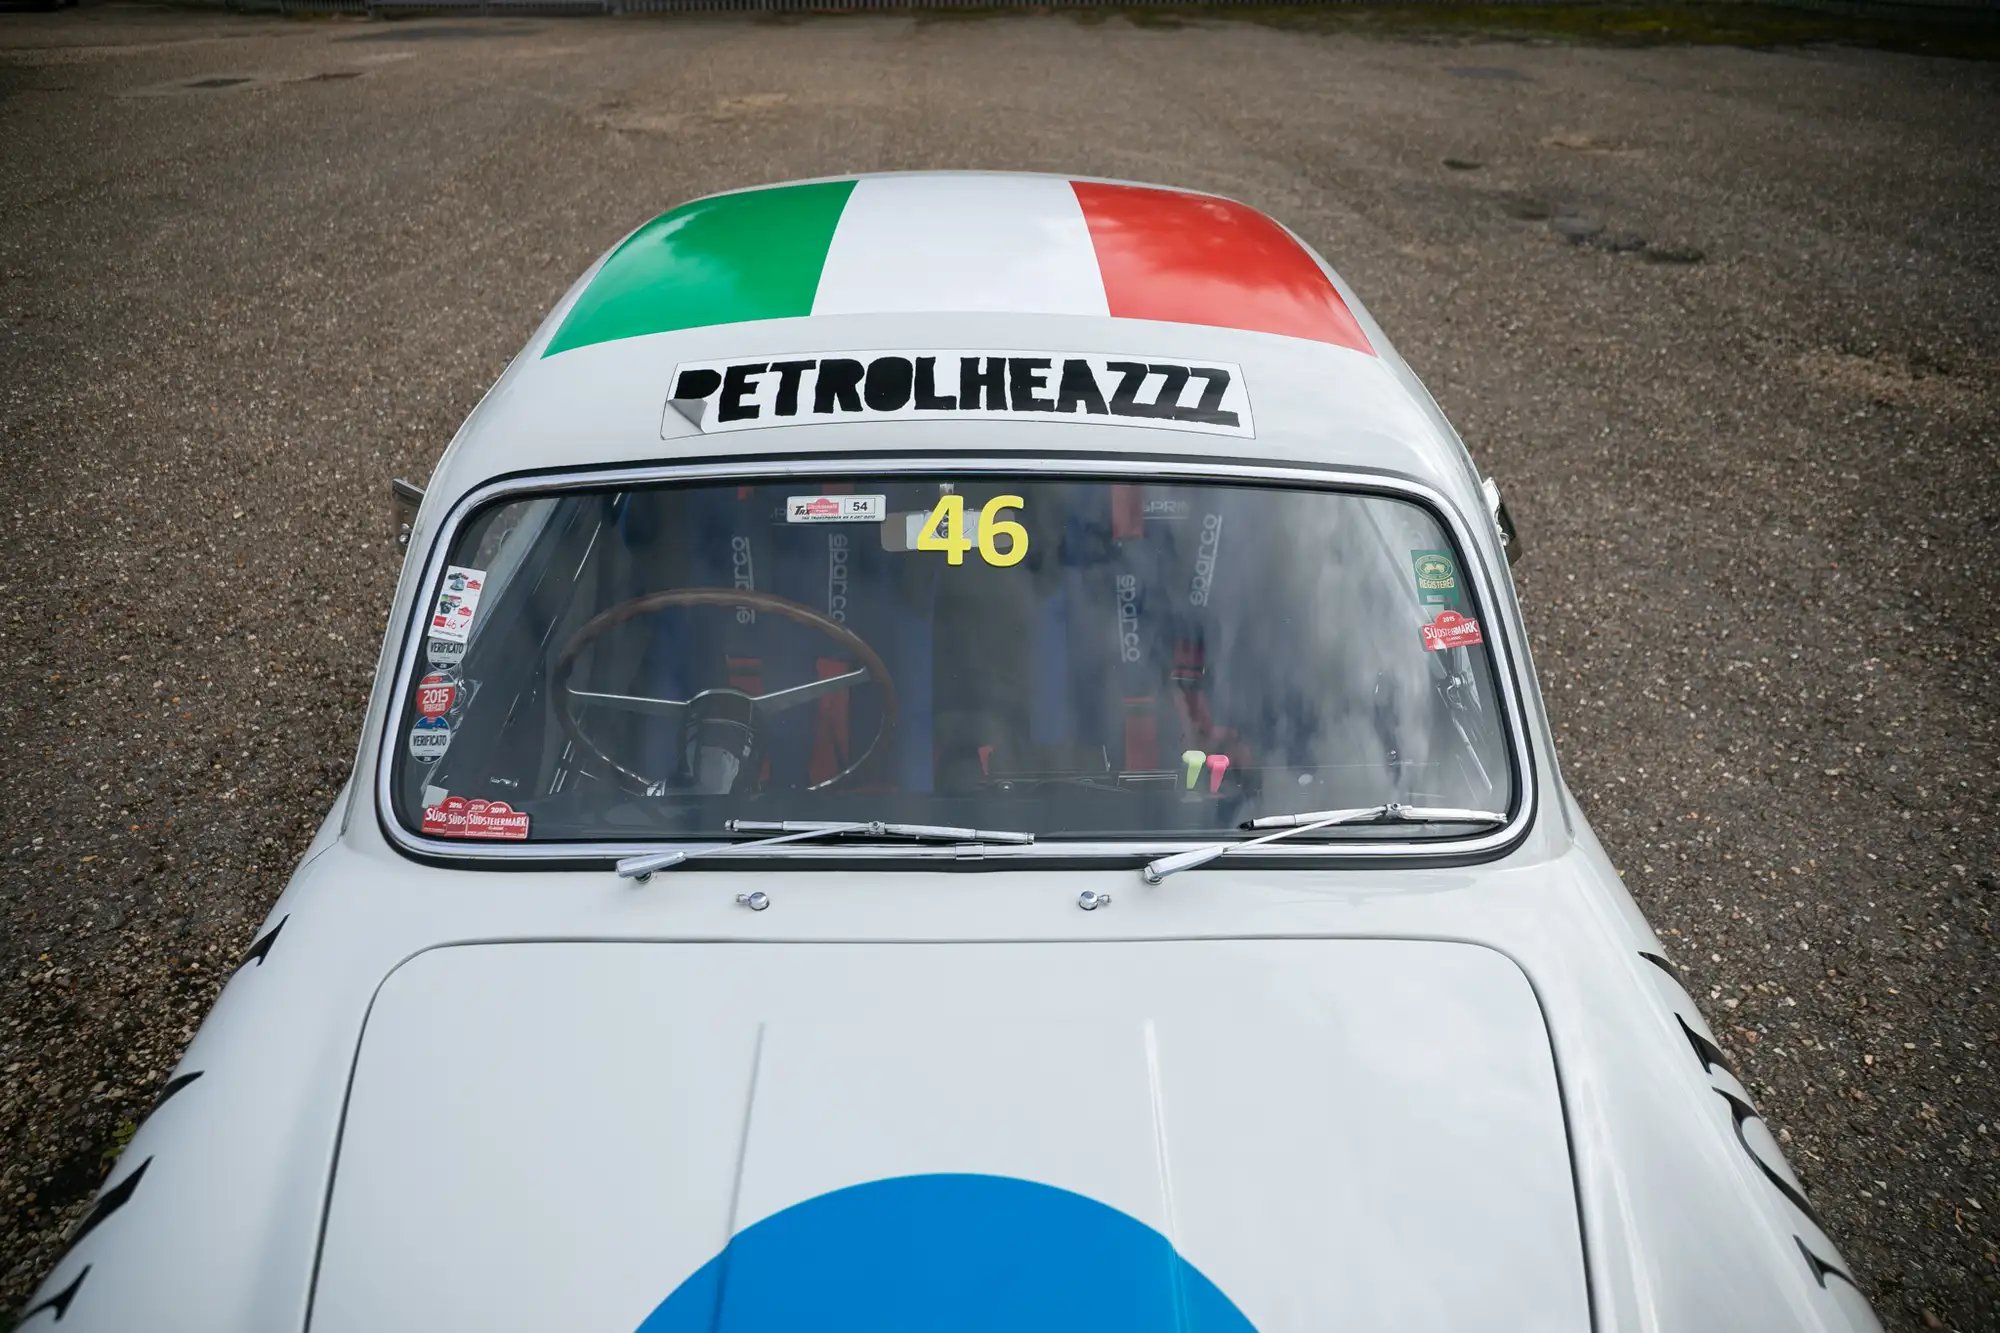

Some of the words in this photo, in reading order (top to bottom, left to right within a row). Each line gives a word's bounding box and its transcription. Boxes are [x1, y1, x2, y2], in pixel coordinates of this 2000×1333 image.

[852, 501, 868, 511] 54
[917, 495, 1029, 567] 46
[1190, 513, 1222, 606] sparco
[731, 536, 755, 624] sarco
[1419, 577, 1454, 589] REGISTERED
[446, 618, 457, 629] 46
[1117, 573, 1141, 662] sparco
[430, 642, 464, 654] VERIFICATO
[422, 688, 449, 704] 2015
[413, 734, 448, 746] VERIFICATO
[469, 812, 527, 827] SÜDSTEIERMARK
